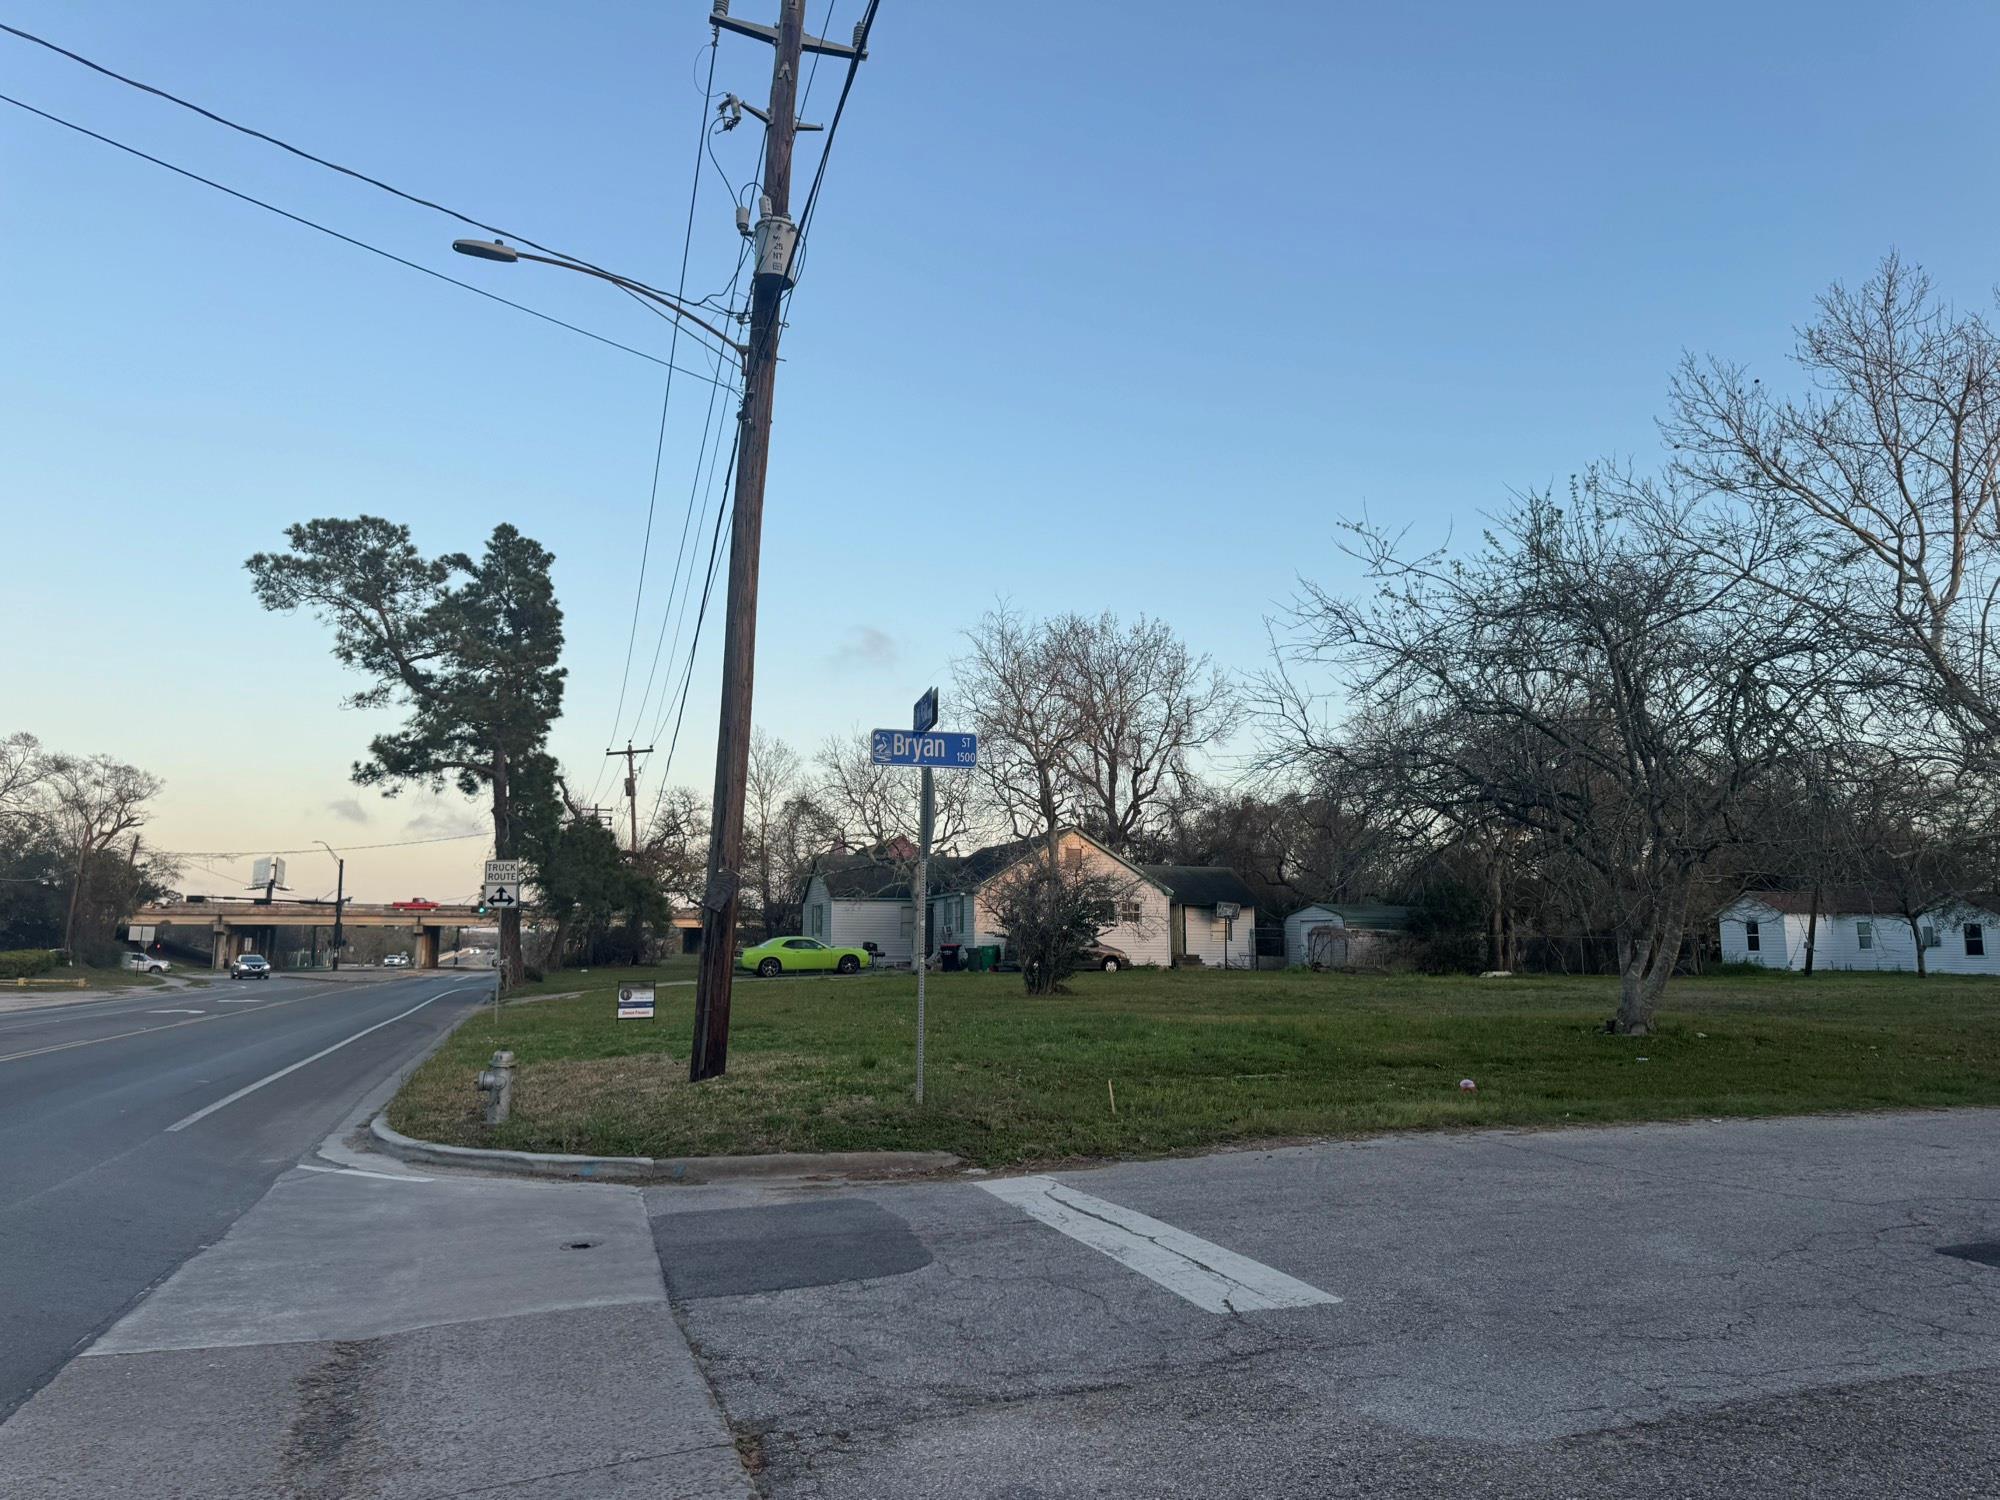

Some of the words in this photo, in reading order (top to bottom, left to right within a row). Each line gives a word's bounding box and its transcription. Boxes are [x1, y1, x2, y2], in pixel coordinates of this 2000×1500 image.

[893, 733, 945, 763] Bryan
[961, 737, 971, 748] ST
[956, 752, 976, 763] 1500
[488, 863, 516, 872] TRUCK
[488, 872, 516, 881] ROUTE
